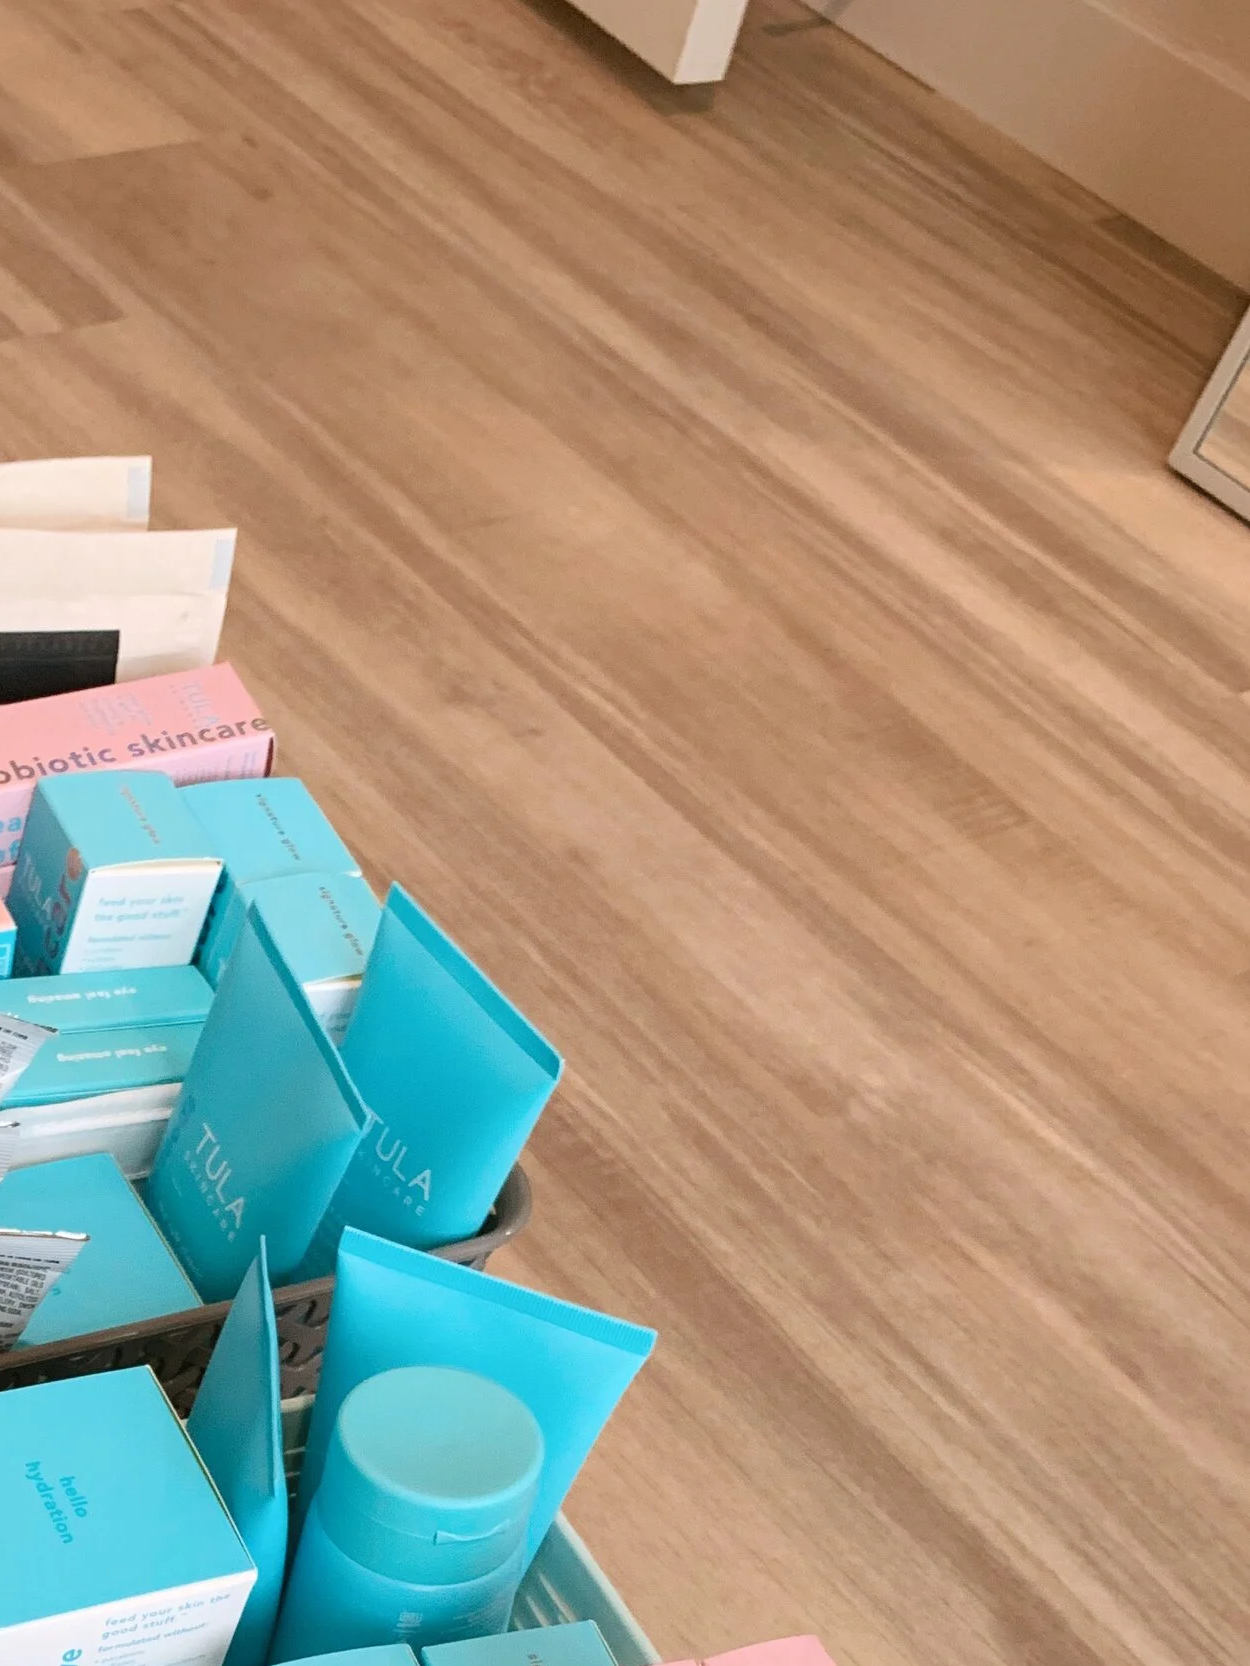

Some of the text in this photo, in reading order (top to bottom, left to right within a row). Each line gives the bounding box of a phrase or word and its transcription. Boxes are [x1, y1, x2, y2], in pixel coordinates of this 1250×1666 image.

[127, 715, 272, 759] skincare
[318, 885, 349, 929] signature
[194, 1122, 245, 1229] TULA
[25, 1460, 75, 1545] hydration
[60, 1475, 88, 1520] hello
[104, 1612, 138, 1628] feed
[140, 1606, 174, 1622] your
[176, 1599, 205, 1614] skin
